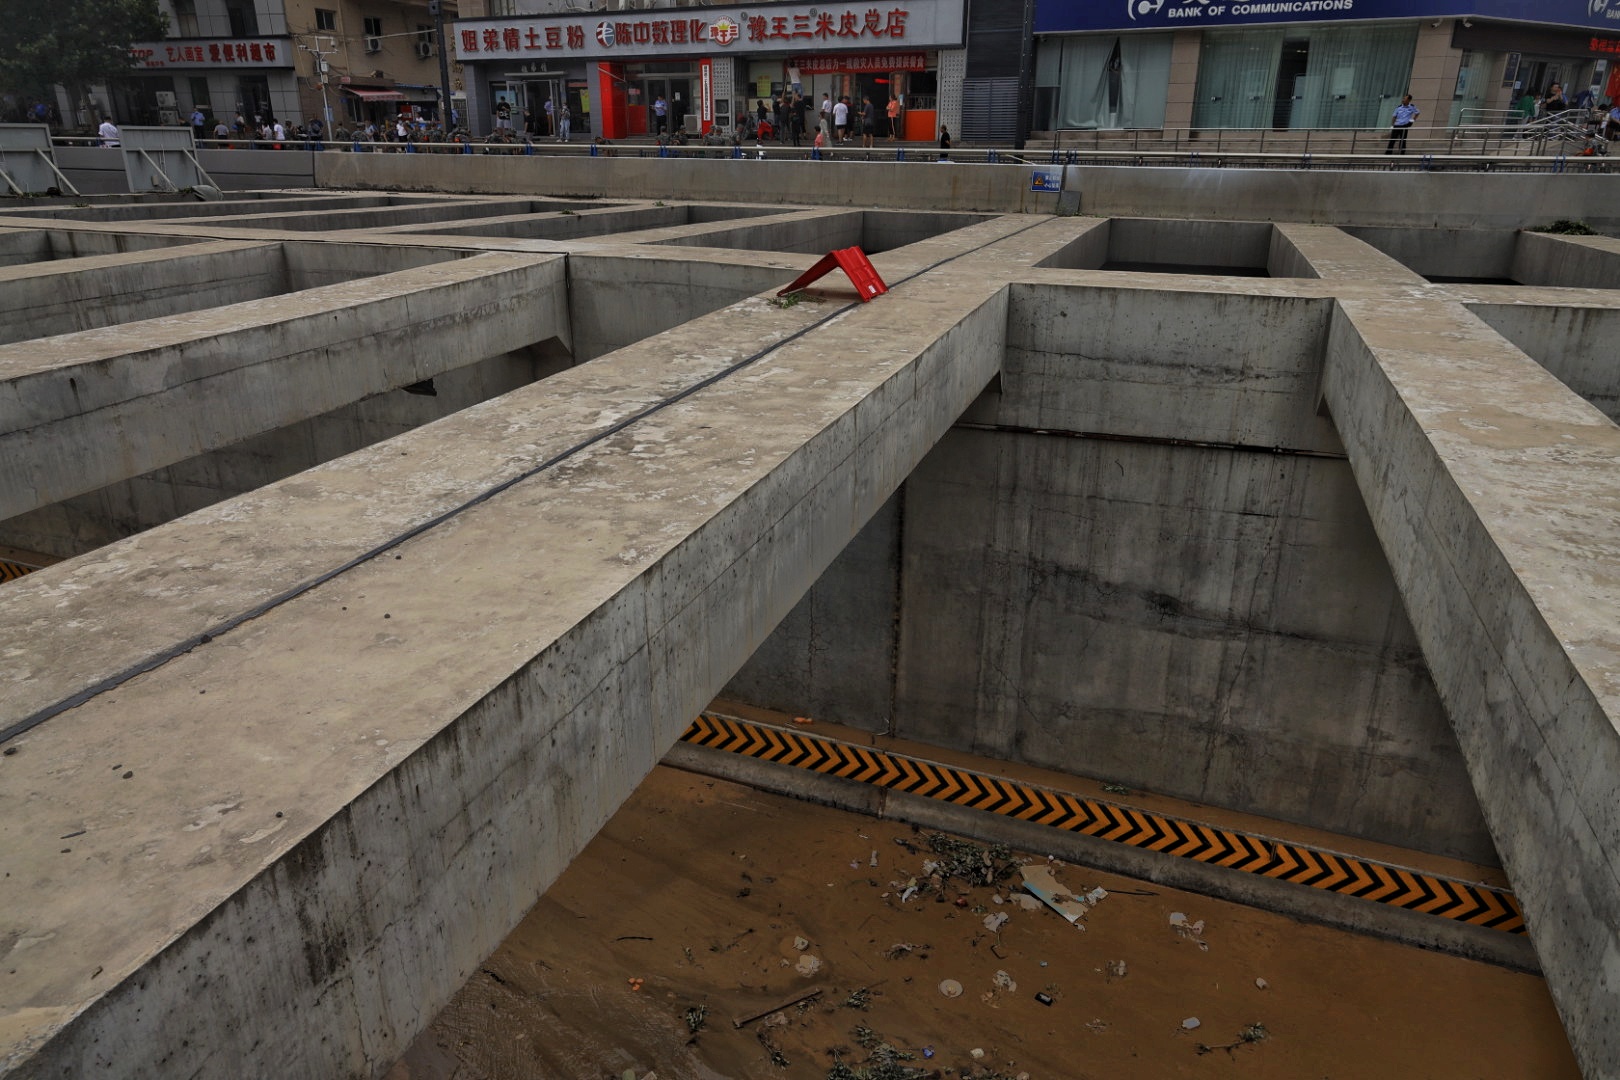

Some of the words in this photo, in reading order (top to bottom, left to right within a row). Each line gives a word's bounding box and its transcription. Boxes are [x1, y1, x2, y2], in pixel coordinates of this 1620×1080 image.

[1167, 7, 1203, 18] BANK
[1208, 6, 1226, 16] OF
[1232, 0, 1353, 15] COMMUNICATIONS
[461, 25, 585, 52] 姐弟情土豆粉
[614, 19, 708, 45] 陈中数理化
[747, 9, 908, 42] 豫王三米皮总店
